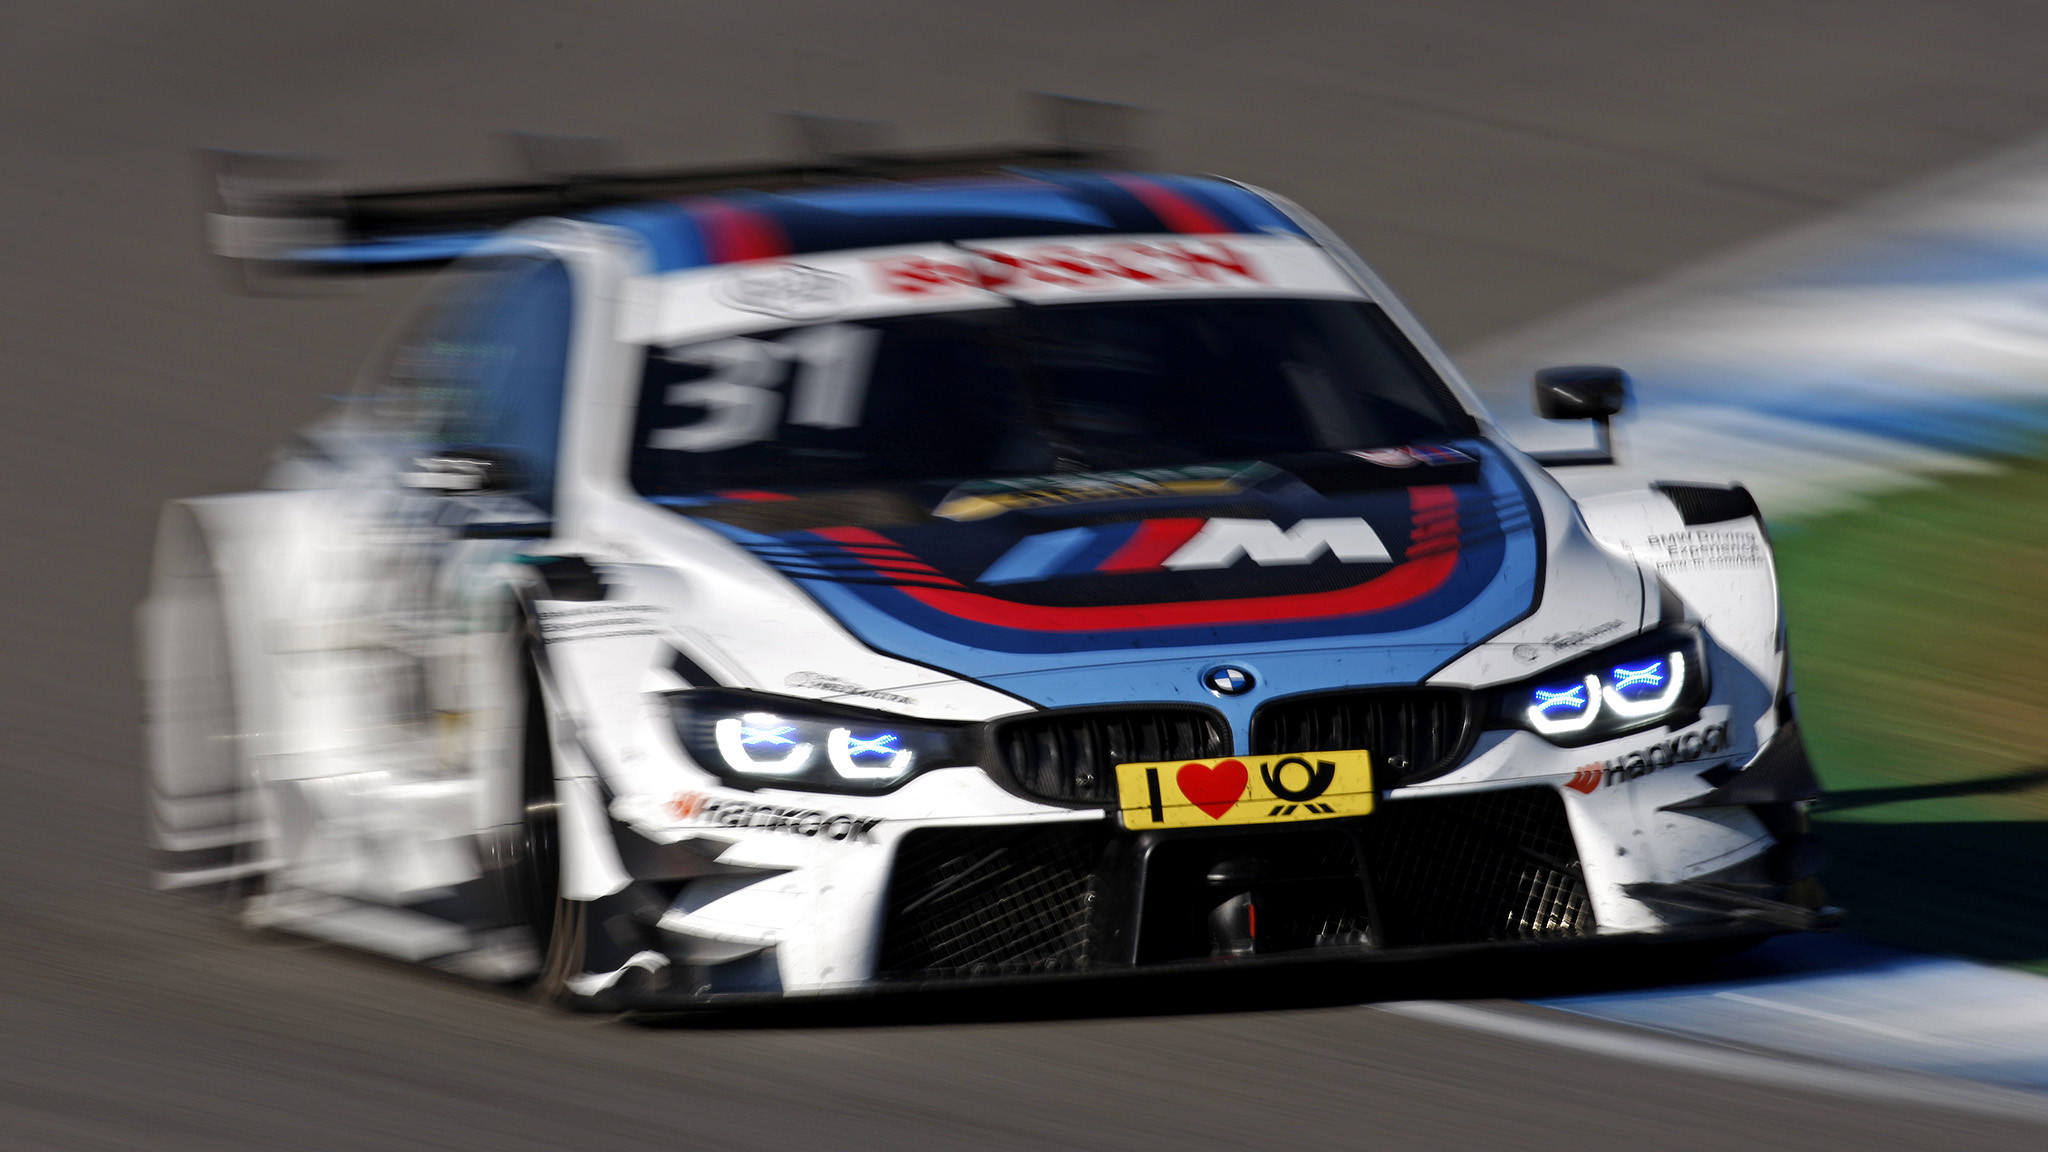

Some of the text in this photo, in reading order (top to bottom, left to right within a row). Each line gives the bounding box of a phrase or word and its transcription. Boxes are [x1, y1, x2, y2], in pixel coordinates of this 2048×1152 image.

[868, 240, 1262, 294] BOSCH
[648, 322, 882, 452] 31
[1647, 530, 1692, 546] BMW
[1145, 767, 1164, 823] I
